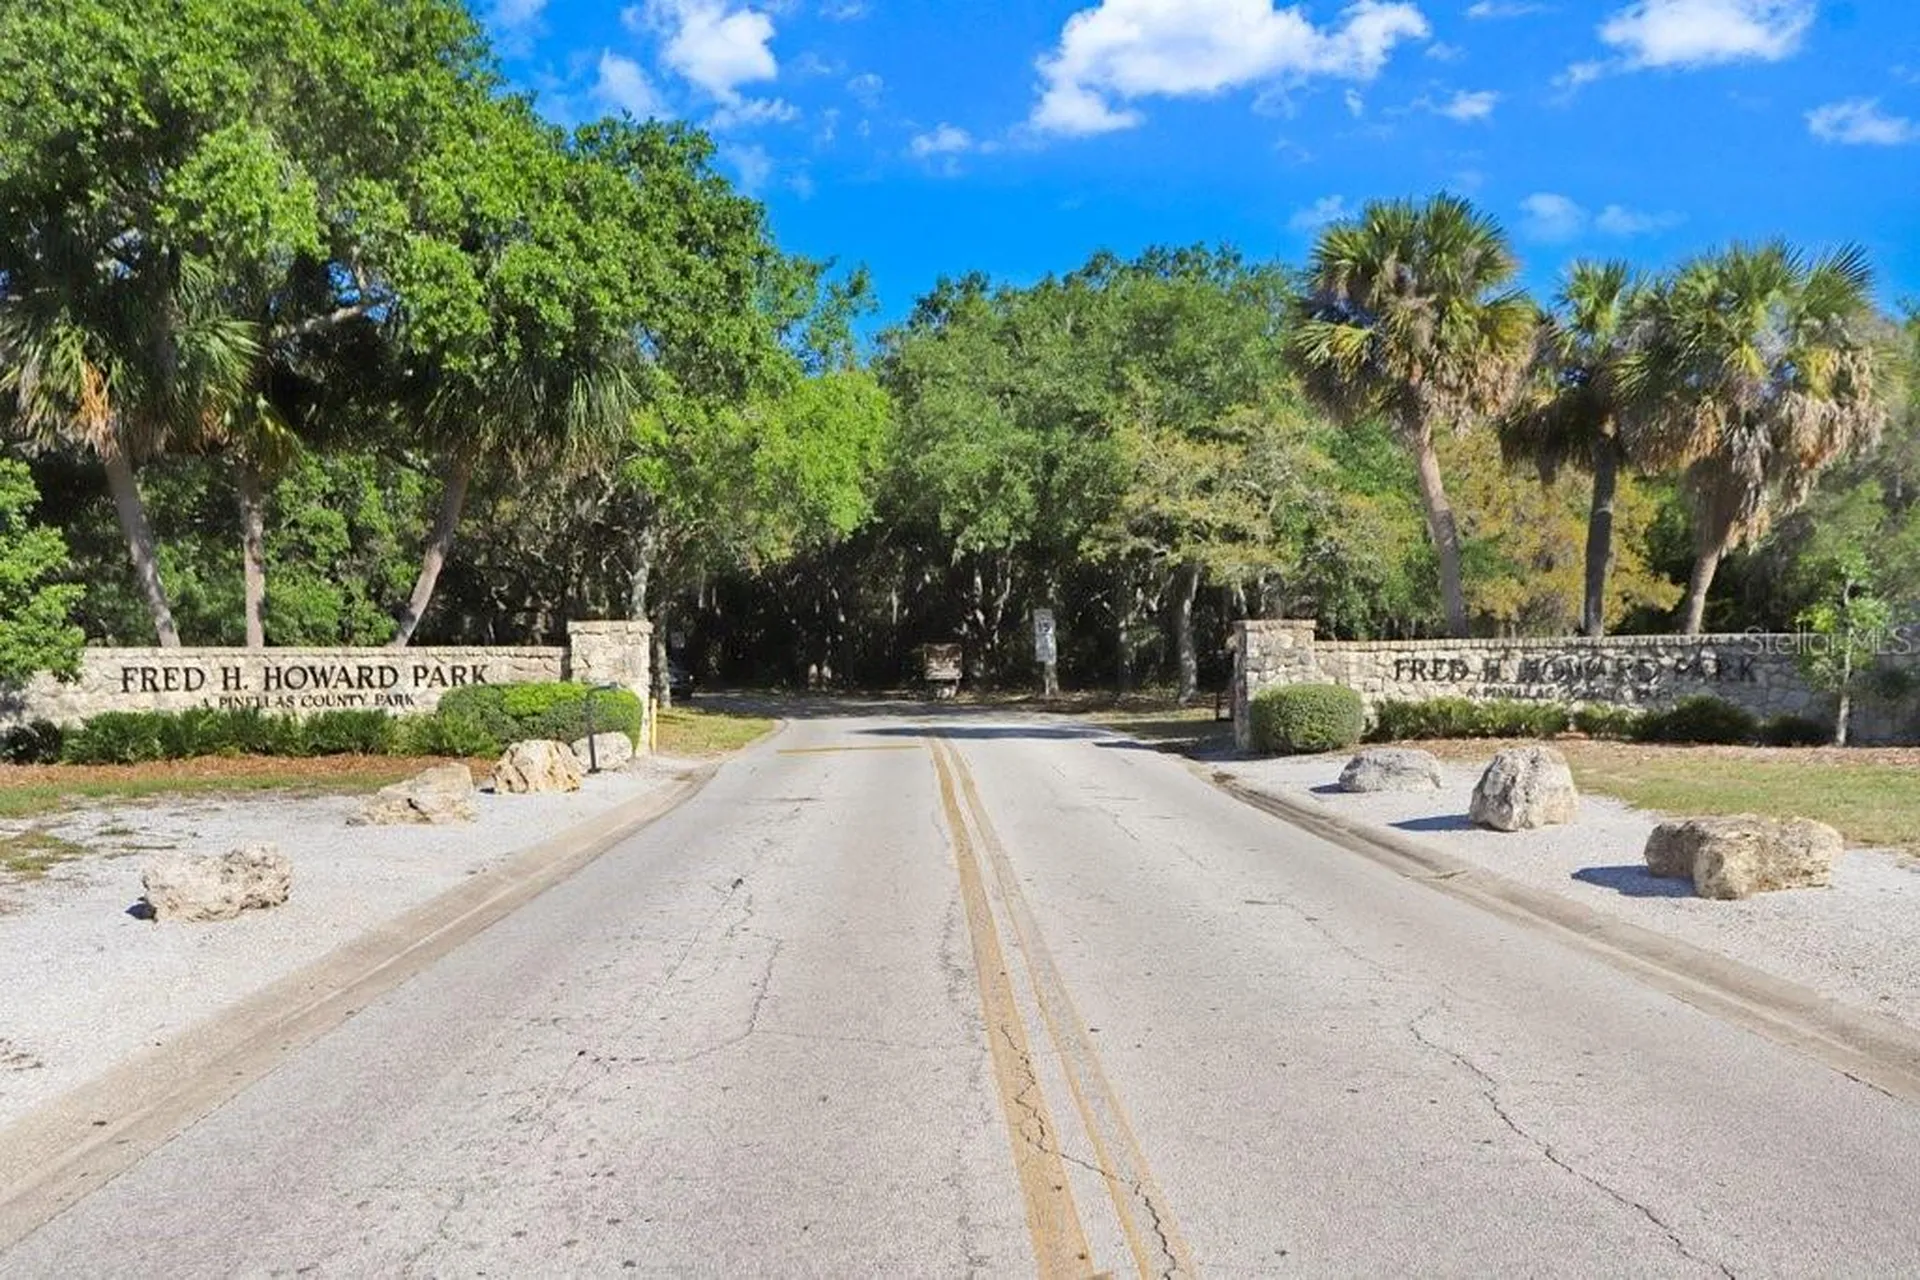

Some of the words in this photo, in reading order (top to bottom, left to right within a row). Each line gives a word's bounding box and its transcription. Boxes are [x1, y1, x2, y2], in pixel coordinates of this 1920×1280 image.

[121, 666, 205, 693] FRED
[222, 666, 248, 691] H.
[264, 664, 399, 690] HOWARD
[412, 664, 489, 688] PARK
[1393, 658, 1469, 682] FRED
[301, 694, 368, 707] COUNTY
[375, 693, 415, 708] PARK
